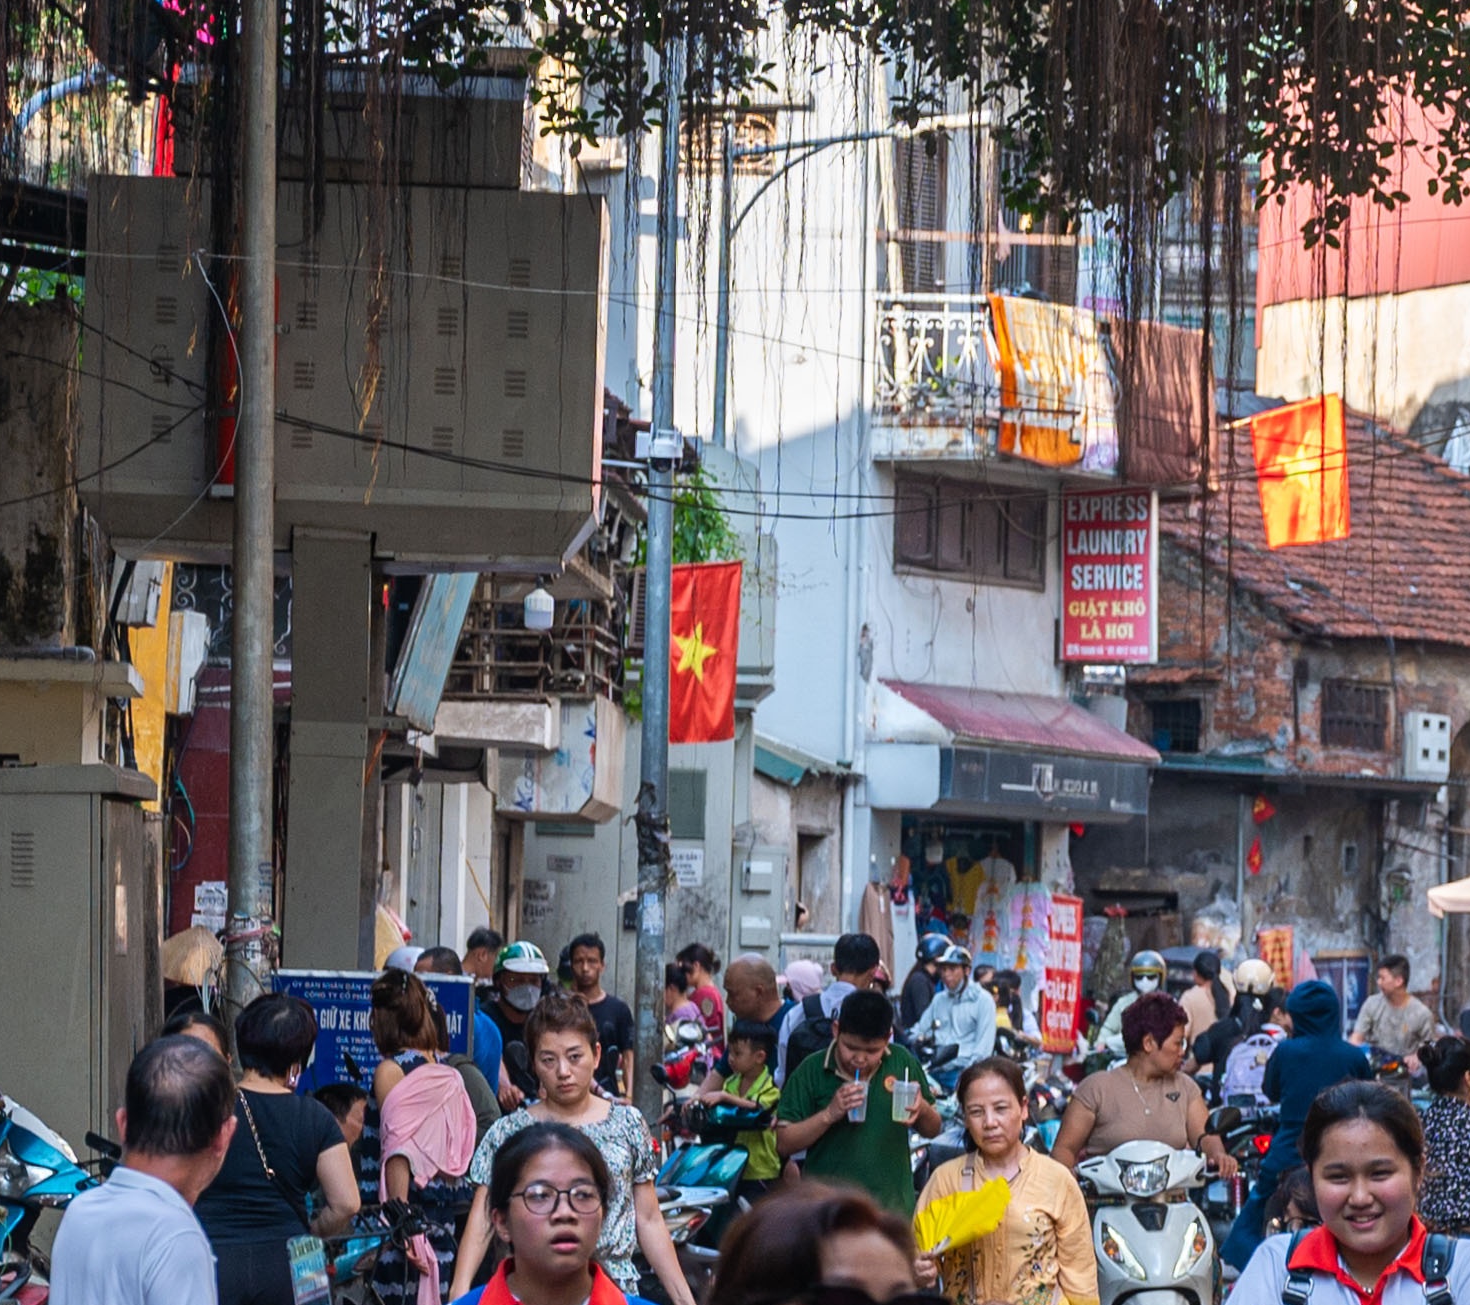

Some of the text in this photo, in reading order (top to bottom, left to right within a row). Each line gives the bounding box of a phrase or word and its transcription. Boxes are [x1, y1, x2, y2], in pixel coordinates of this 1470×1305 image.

[1067, 497, 1148, 522] EXPRESS
[1067, 529, 1148, 556] LAUNDRY
[1071, 564, 1144, 591] SERVICE
[320, 1006, 338, 1030] GIỮ
[339, 1011, 351, 1030] XE
